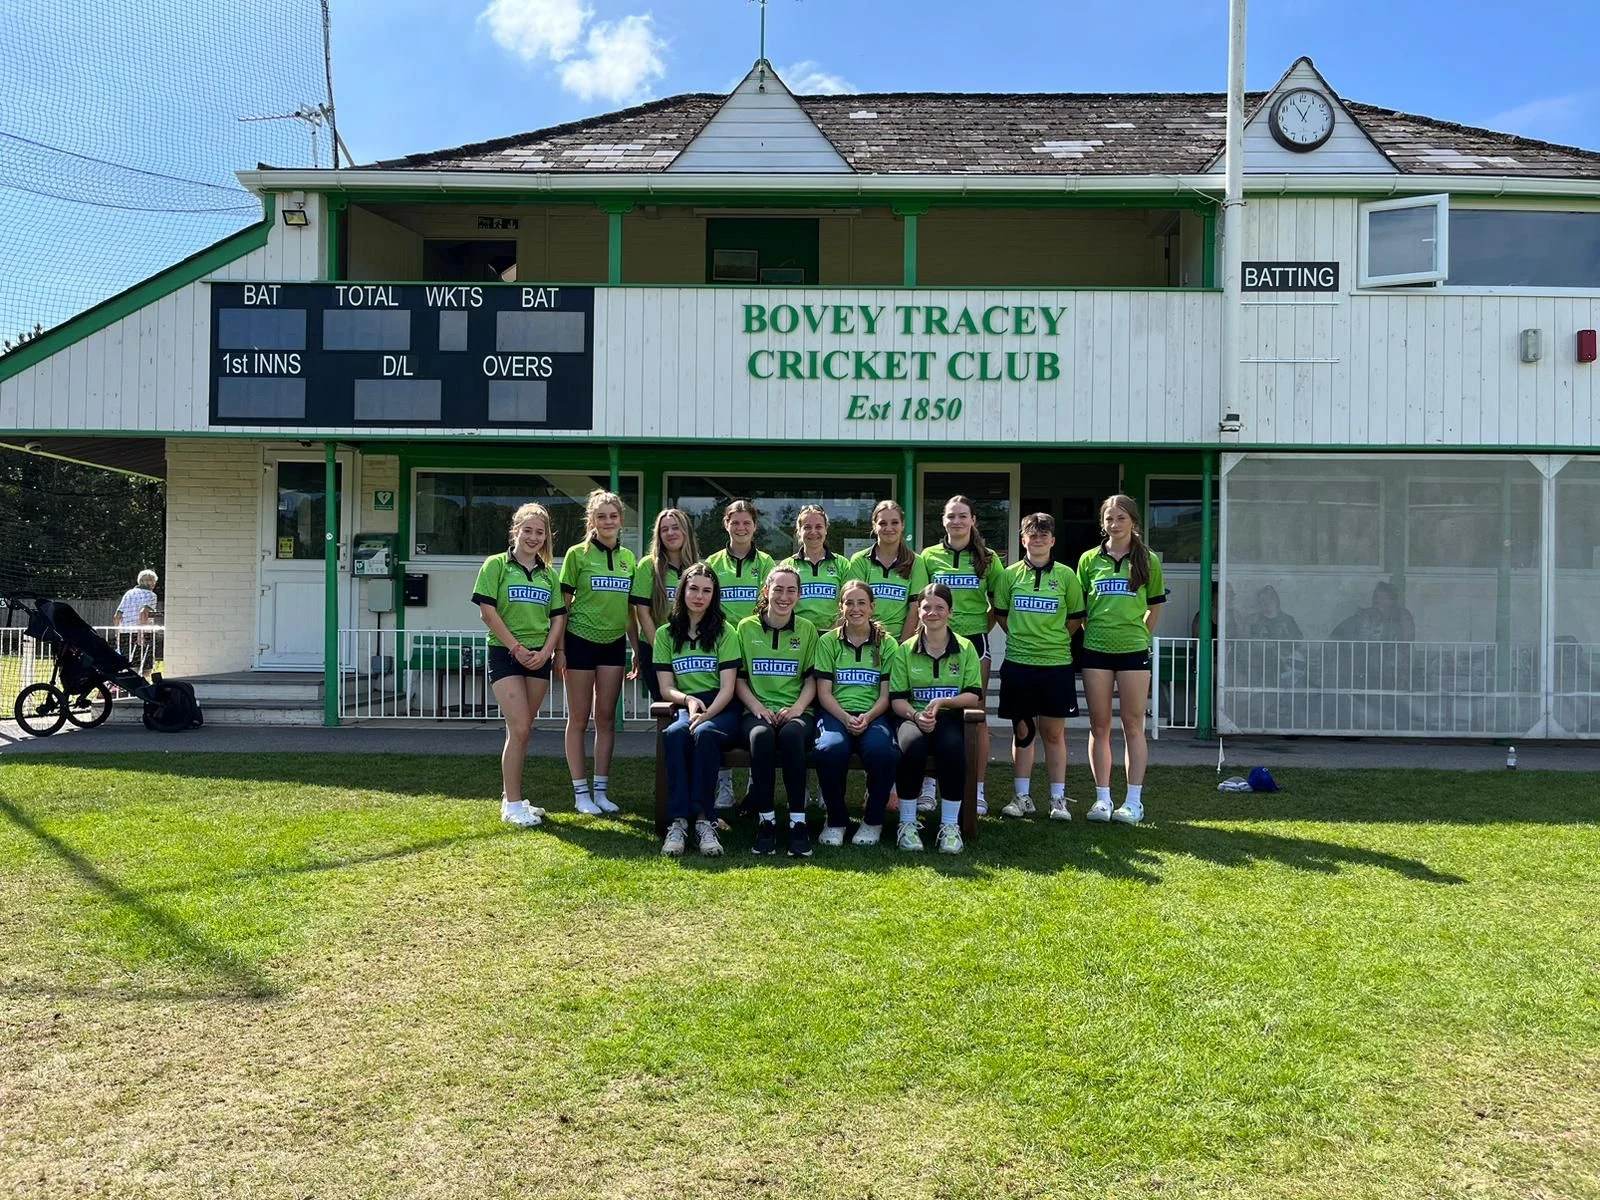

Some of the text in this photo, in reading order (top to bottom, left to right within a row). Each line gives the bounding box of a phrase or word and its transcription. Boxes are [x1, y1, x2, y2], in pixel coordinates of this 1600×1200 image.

[1245, 267, 1334, 287] BATTING
[244, 284, 282, 305] BAT
[336, 285, 399, 306] TOTAL
[426, 287, 483, 307] WKTS
[522, 287, 559, 308] BAT
[742, 304, 1067, 336] BOVEY TRACEY
[222, 353, 301, 375] 1st INNS
[383, 355, 414, 377] D/L
[482, 355, 553, 378] OVERS
[747, 350, 1061, 382] CRICKET CLUB
[845, 394, 963, 421] Est 1850
